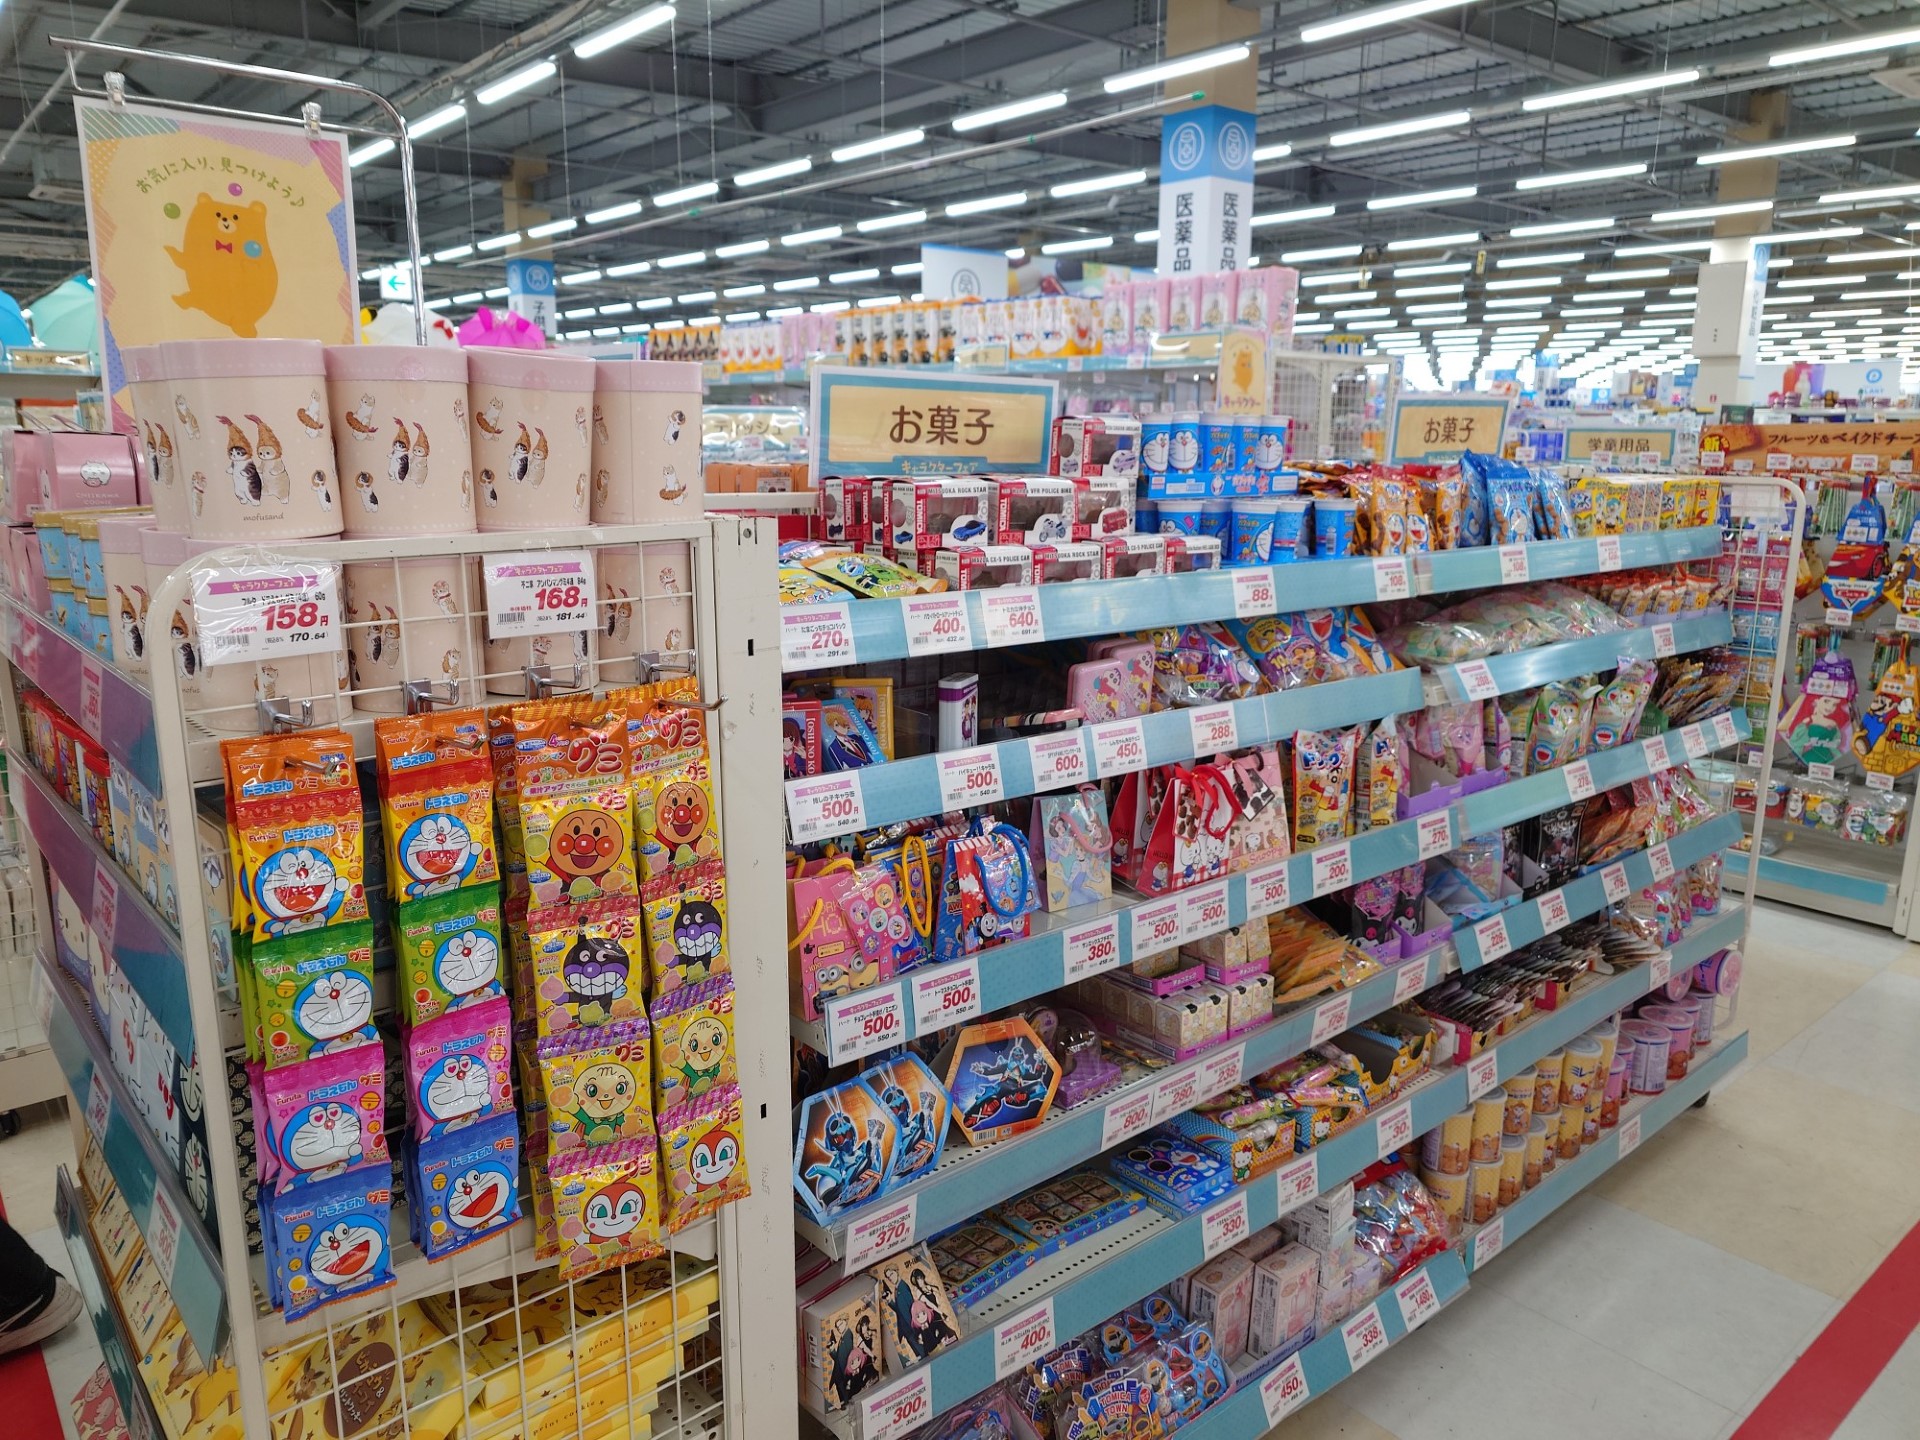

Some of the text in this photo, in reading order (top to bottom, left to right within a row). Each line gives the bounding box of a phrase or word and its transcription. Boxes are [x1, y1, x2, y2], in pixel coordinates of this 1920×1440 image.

[1174, 192, 1193, 272] 医薬品
[1221, 192, 1238, 271] 医薬品
[889, 405, 994, 446] お菓子
[1423, 416, 1475, 444] お菓子
[1587, 437, 1650, 452] 学童用品
[901, 460, 978, 473] キャラクターフェア
[915, 498, 924, 535] TOMICA
[999, 497, 1007, 531] TOMICA
[659, 708, 702, 749] グミ
[391, 752, 436, 769] ドラえもん
[516, 750, 567, 767] アンパンマン
[568, 732, 624, 775] グミ
[807, 743, 815, 759] NO
[242, 780, 294, 797] ドラえもん
[966, 770, 998, 790] 500円
[424, 794, 468, 809] ドラえもん
[821, 798, 859, 820] 500円
[283, 825, 335, 843] ドラえもん
[1249, 848, 1285, 866] Snoopy
[434, 915, 476, 934] ドラえもん
[296, 953, 347, 975] ドラえもん
[942, 986, 976, 1010] 500円
[863, 1012, 900, 1038] 500円
[442, 1033, 485, 1054] ドラえもん
[570, 1048, 613, 1063] アンパンマン
[307, 1080, 358, 1101] ドラえもん
[451, 1145, 492, 1168] ドラえもん
[1125, 1167, 1166, 1195] DORAEMON
[316, 1196, 366, 1219] ドラえもん
[875, 1222, 911, 1248] 370円
[892, 1395, 928, 1425] 300円
[1101, 1391, 1131, 1407] TOMICA
[1104, 1403, 1129, 1416] TOWN
